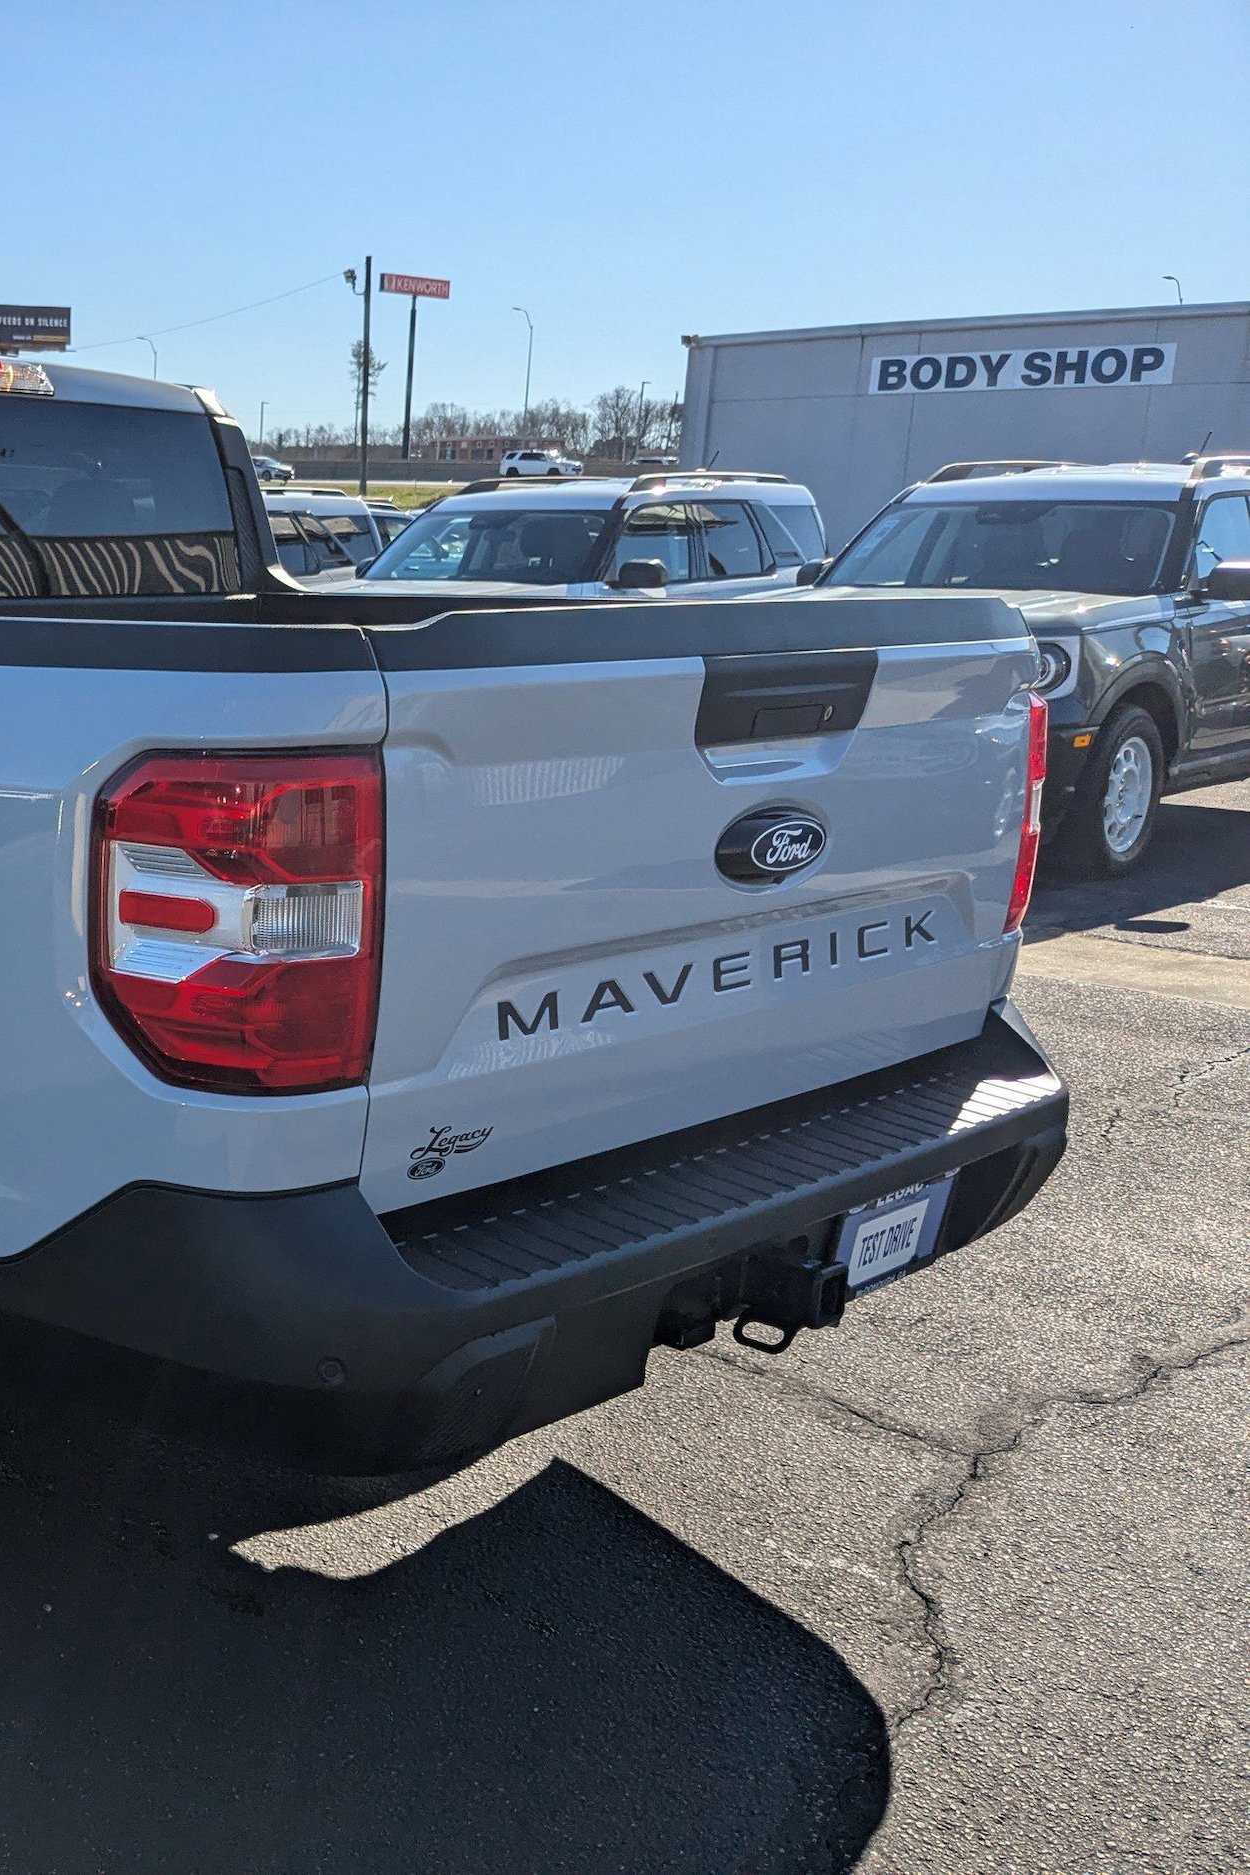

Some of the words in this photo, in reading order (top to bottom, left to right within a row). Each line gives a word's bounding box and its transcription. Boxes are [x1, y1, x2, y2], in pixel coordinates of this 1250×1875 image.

[396, 279, 448, 297] KENWORTH
[25, 318, 34, 326] ON
[38, 318, 67, 327] SILENCE
[877, 353, 1012, 391] BODY
[1021, 347, 1165, 387] SHOP
[766, 828, 813, 864] Ford
[497, 910, 937, 1041] MAVERICK
[410, 1126, 494, 1159] Legacy
[857, 1229, 886, 1268] TEST
[883, 1217, 917, 1258] DRIVE
